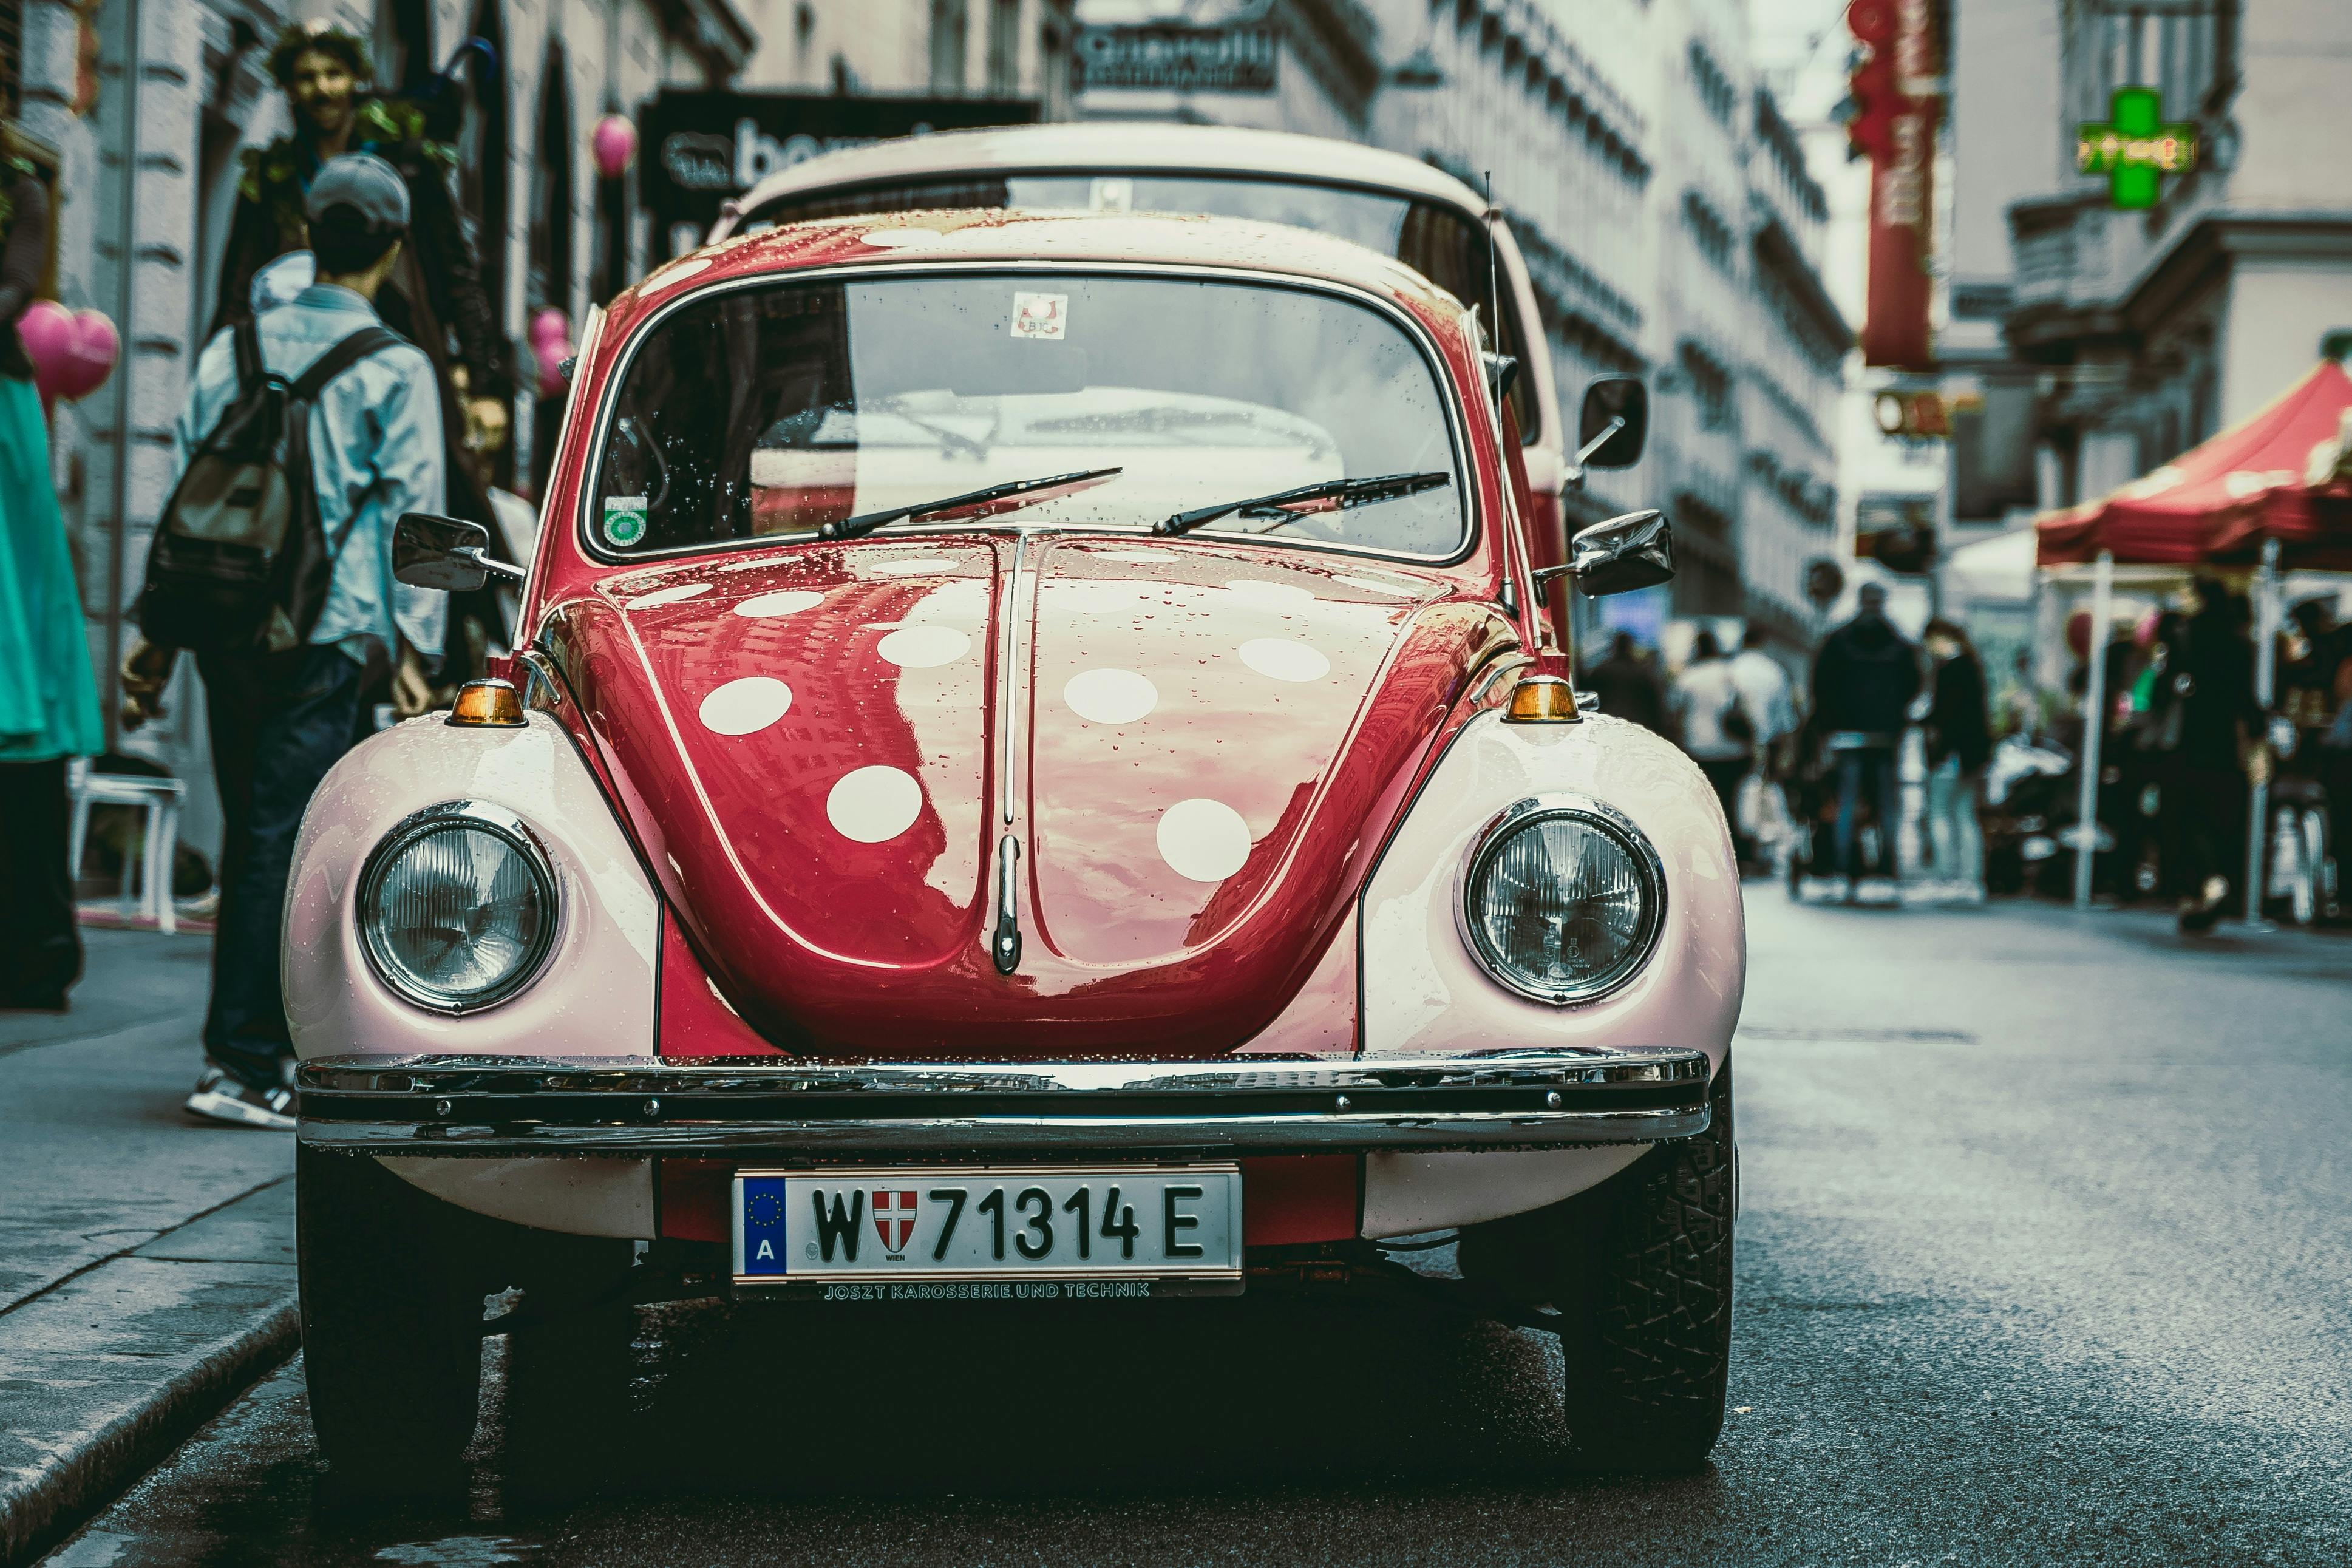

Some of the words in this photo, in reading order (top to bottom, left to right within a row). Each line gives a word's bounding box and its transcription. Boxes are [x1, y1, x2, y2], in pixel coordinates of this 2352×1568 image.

[812, 1187, 866, 1263] W
[928, 1184, 1141, 1261] 71314
[1162, 1184, 1204, 1259] E
[756, 1239, 775, 1260] A
[824, 1285, 886, 1300] JOSZT
[891, 1284, 1010, 1300] KAROSSERIE
[1016, 1283, 1059, 1298] UND
[1065, 1283, 1150, 1297] TECHNIK
